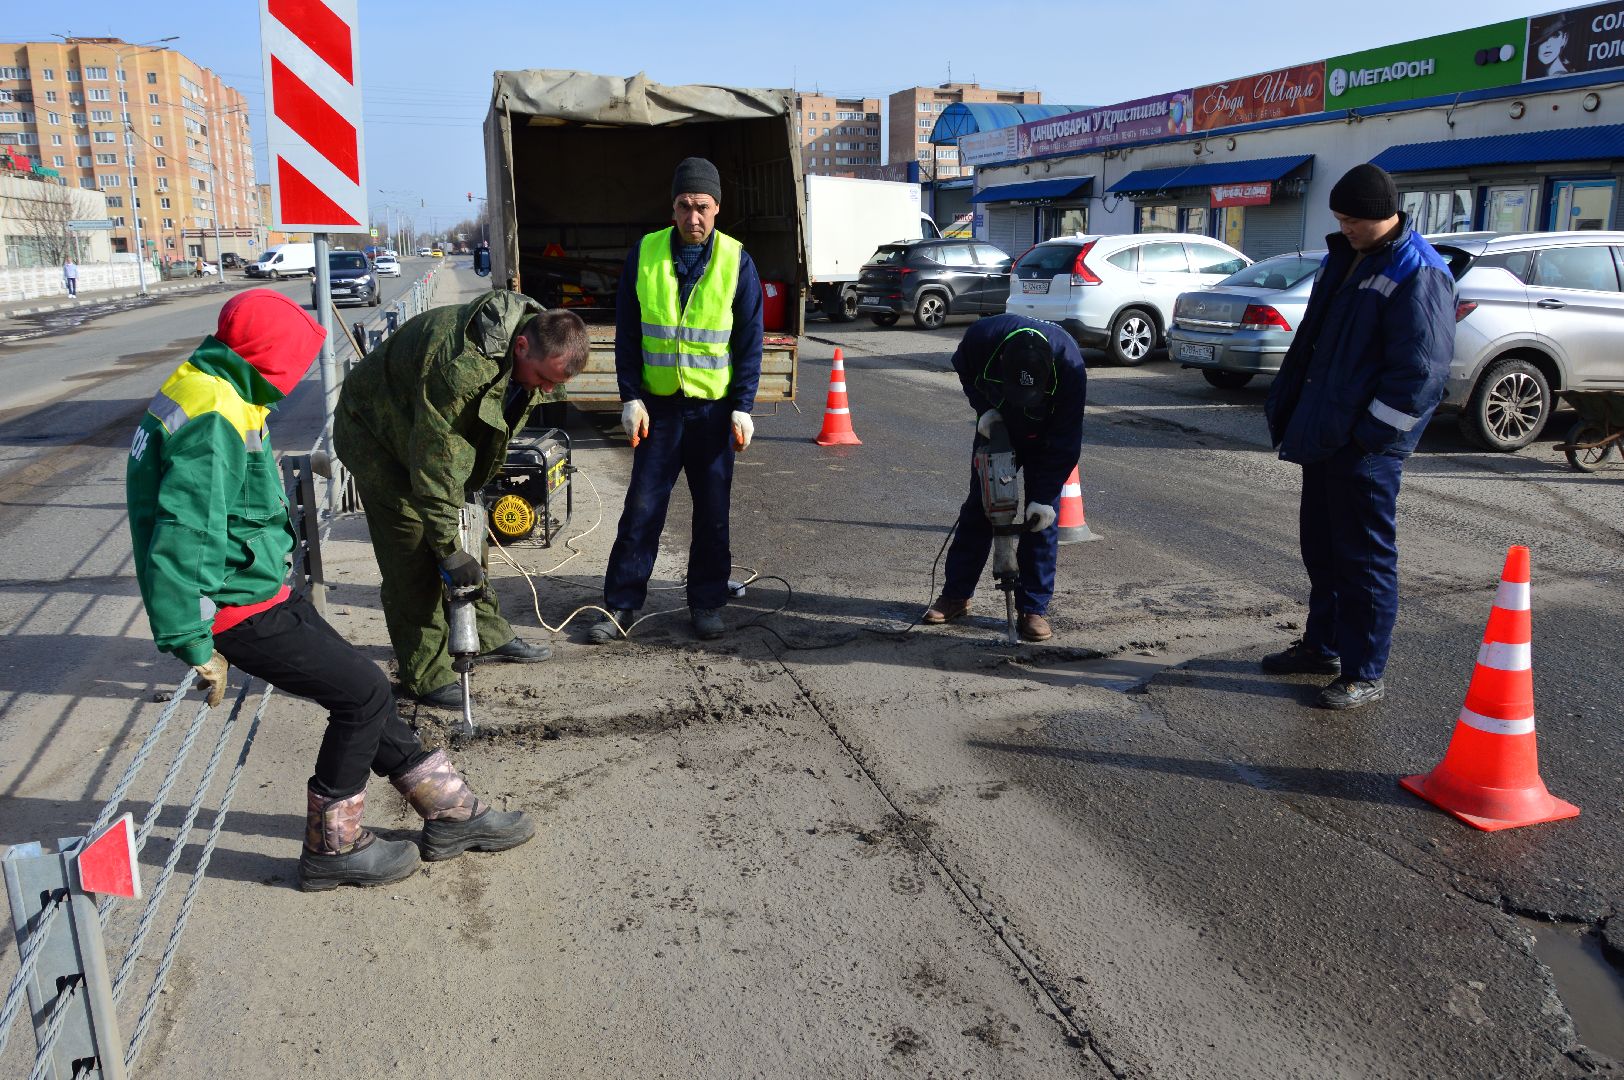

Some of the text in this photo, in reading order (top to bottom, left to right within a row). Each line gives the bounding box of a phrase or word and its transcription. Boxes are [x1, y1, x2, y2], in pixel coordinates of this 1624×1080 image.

[1587, 39, 1624, 61] ГОЛ
[1349, 58, 1435, 88] МЕГАФОН
[1203, 71, 1314, 118] Боди Шарм
[1031, 117, 1091, 143] КАНЦТОВАРЫ
[1101, 101, 1168, 132] Кристины
